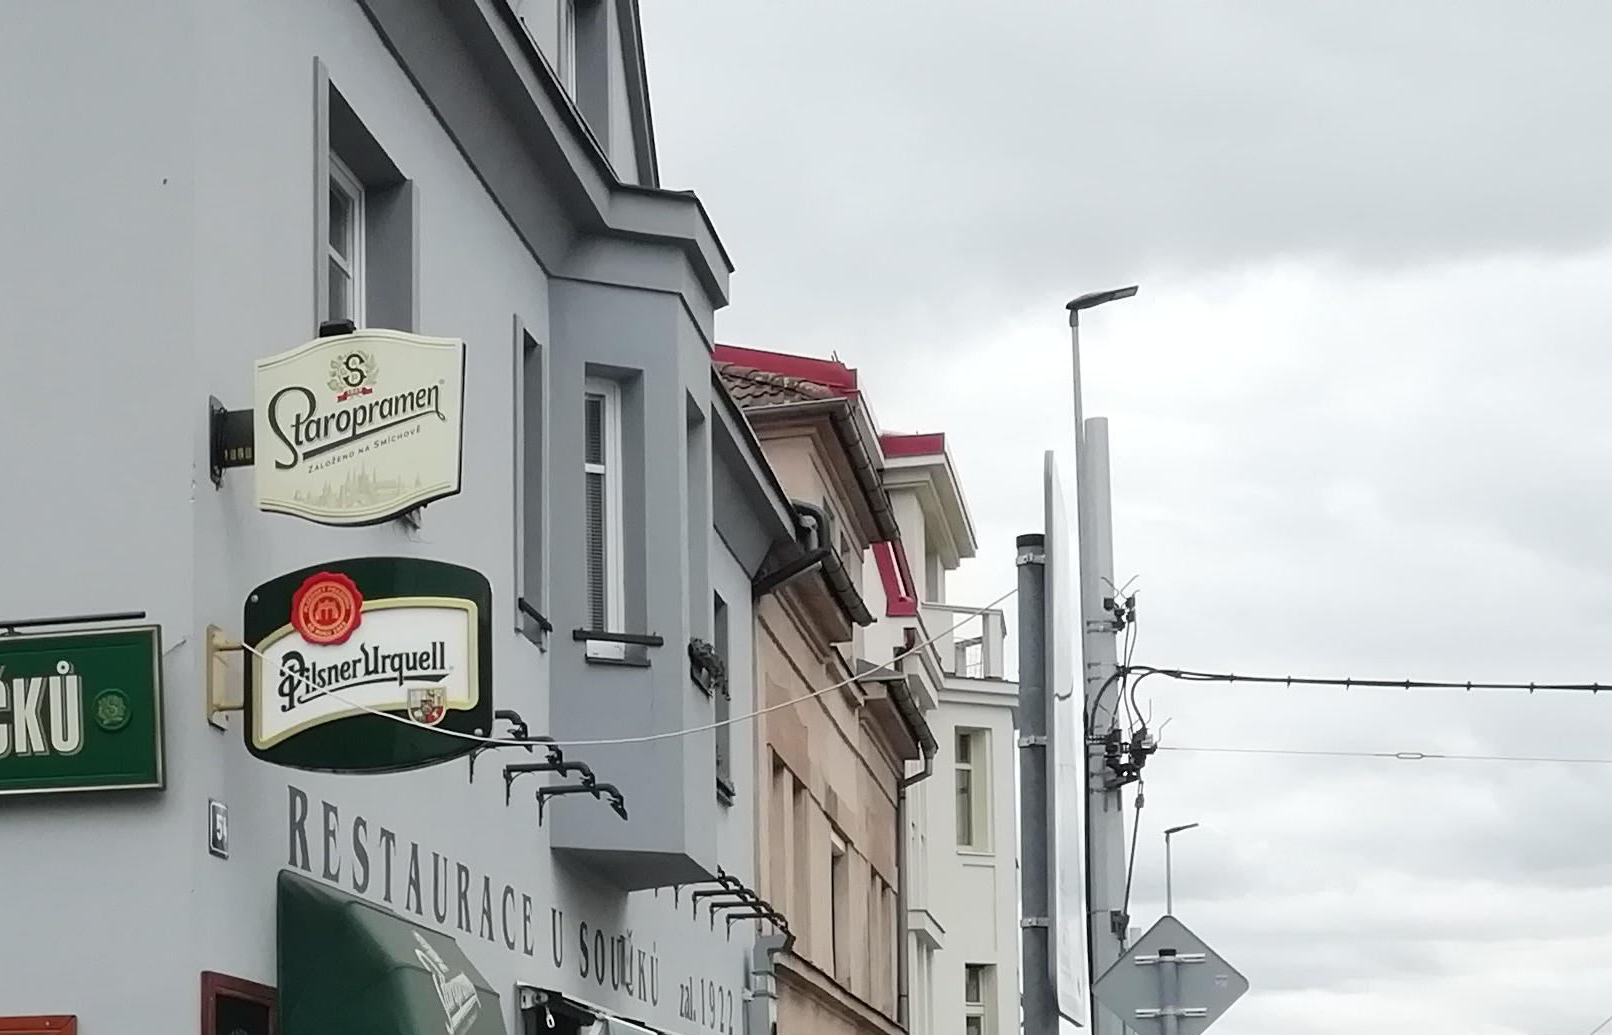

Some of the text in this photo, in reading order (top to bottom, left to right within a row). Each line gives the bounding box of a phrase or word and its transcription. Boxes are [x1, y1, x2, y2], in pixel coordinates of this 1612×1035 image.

[268, 384, 446, 470] Staropramen
[287, 784, 535, 956] RESTAURACE
[551, 907, 563, 969] U
